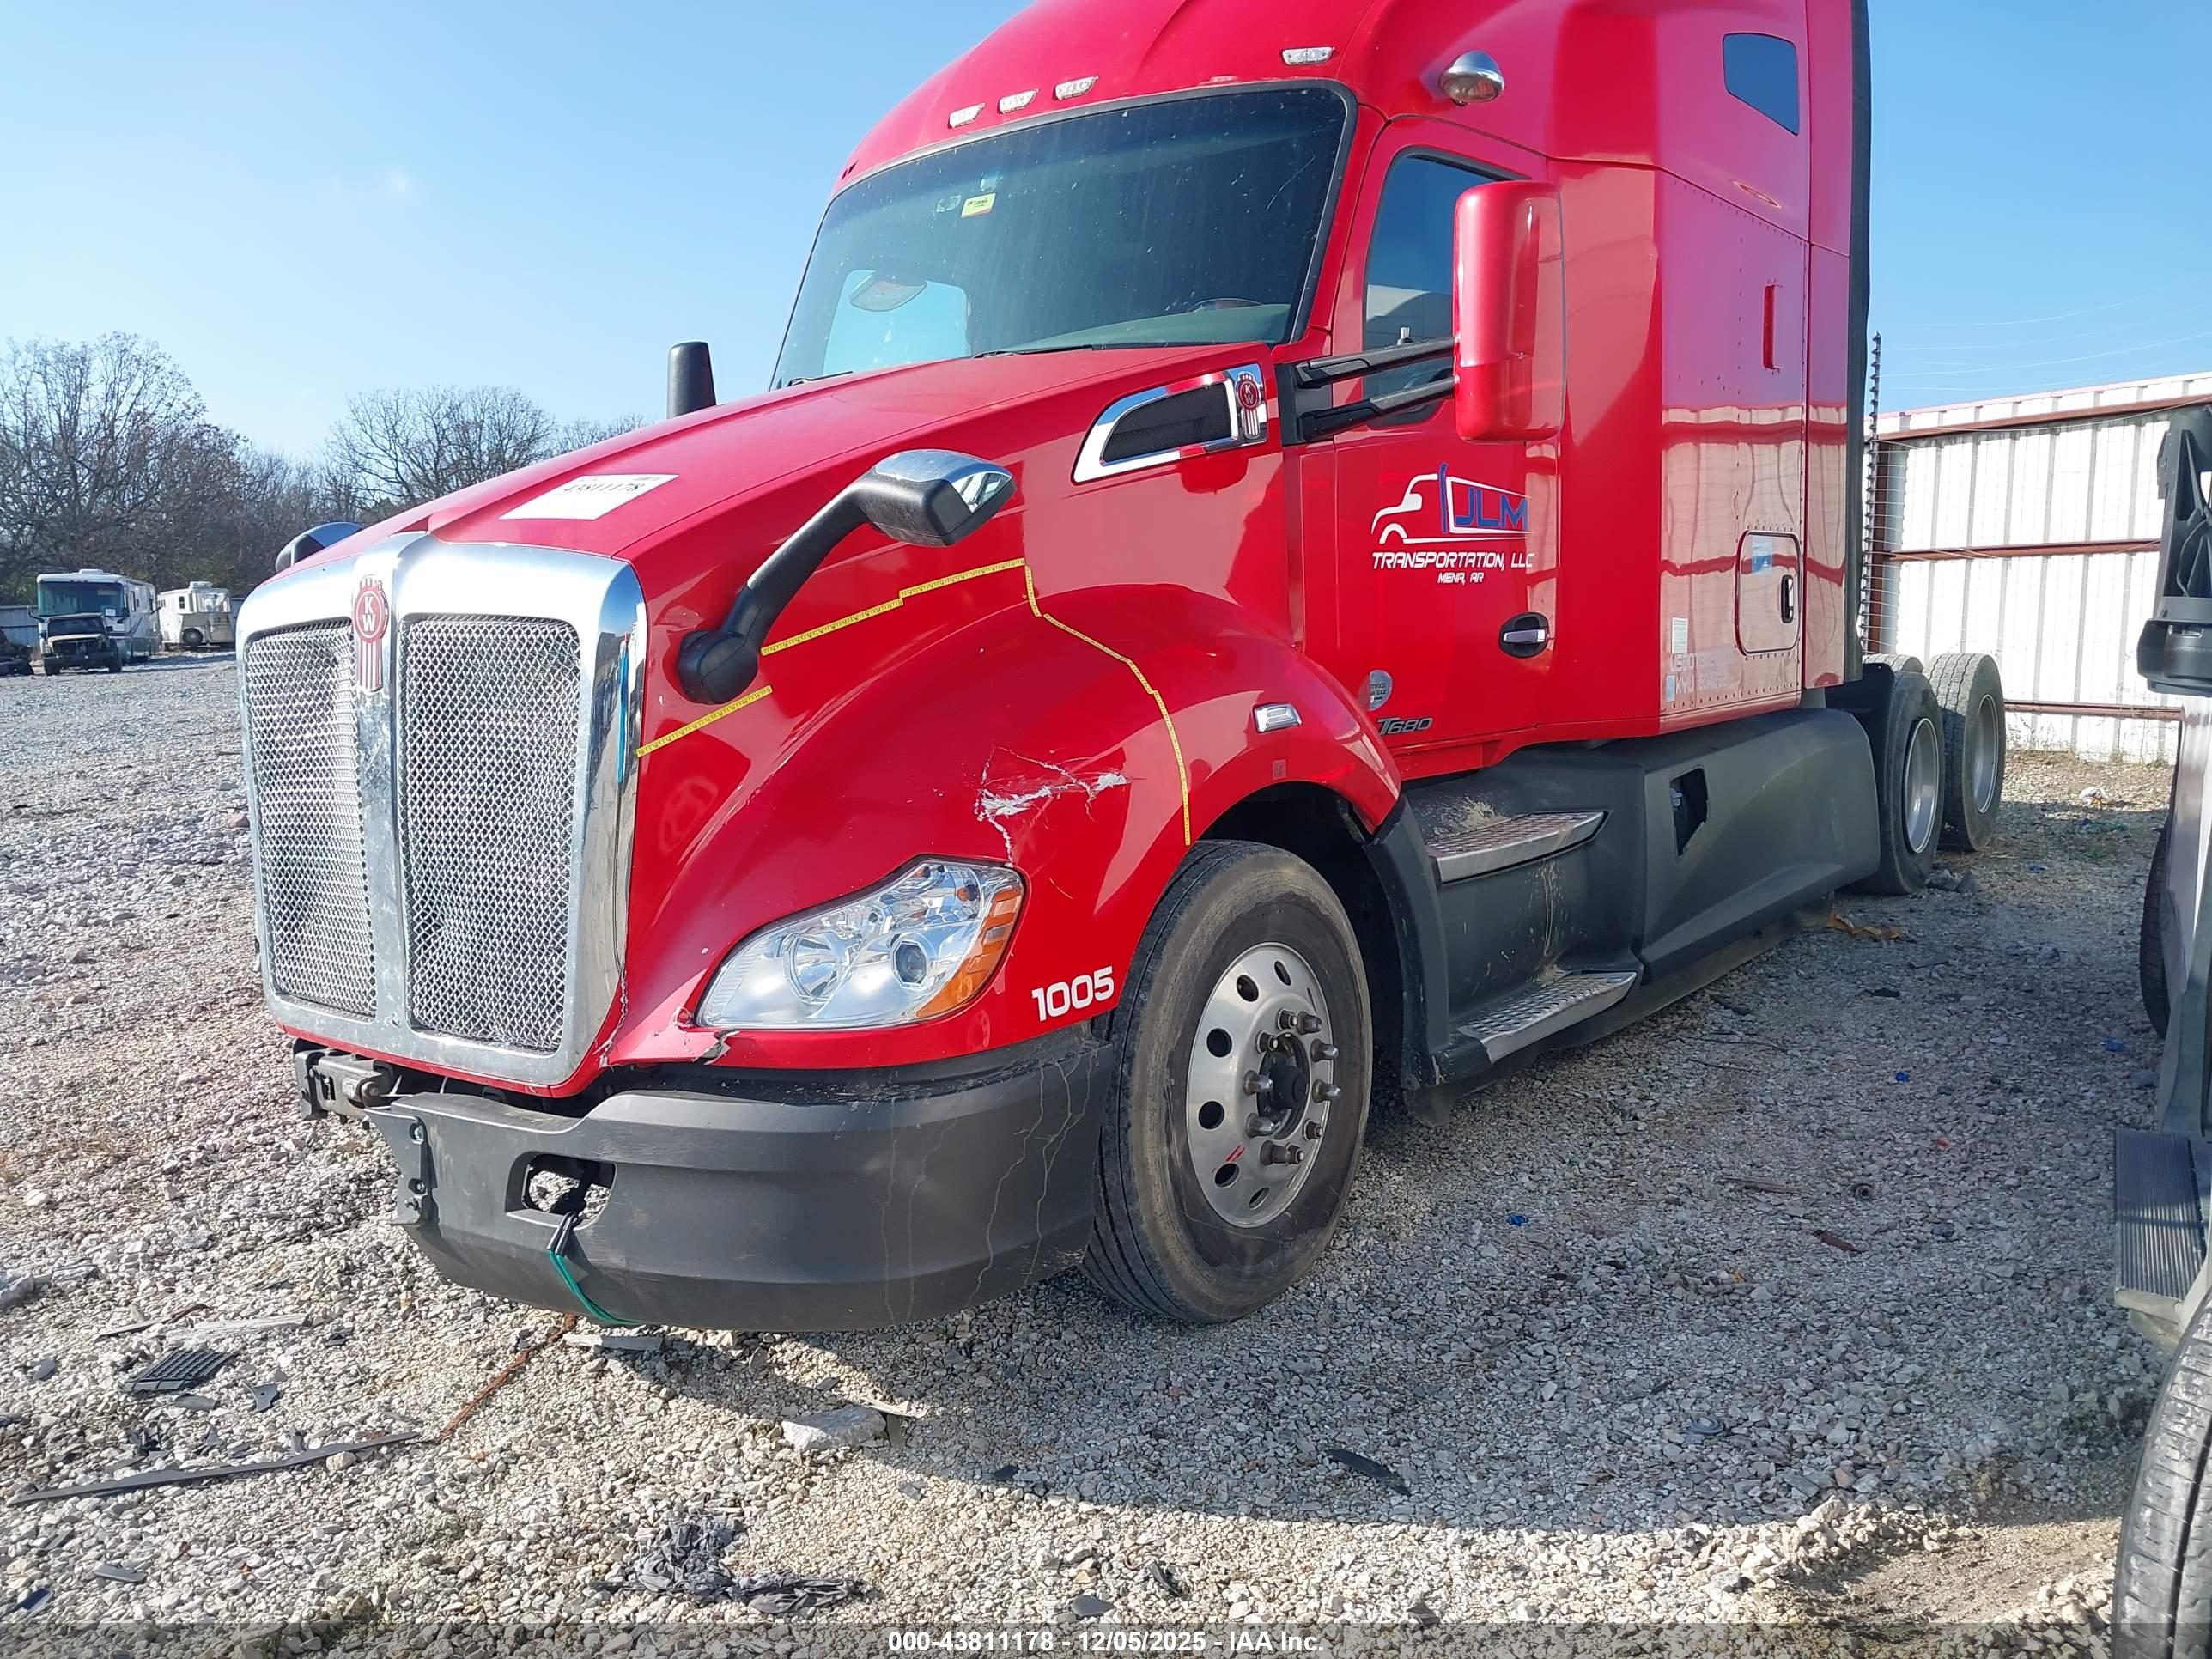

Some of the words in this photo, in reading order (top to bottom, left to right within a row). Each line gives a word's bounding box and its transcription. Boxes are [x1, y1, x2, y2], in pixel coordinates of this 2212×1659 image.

[1455, 487, 1530, 531] JLM
[1371, 551, 1505, 572] TRANSPORTATION,
[1510, 552, 1535, 568] LLC
[1437, 572, 1466, 586] MENA,
[1470, 572, 1484, 583] AR
[1377, 718, 1433, 735] T680
[1030, 965, 1115, 1022] 1005
